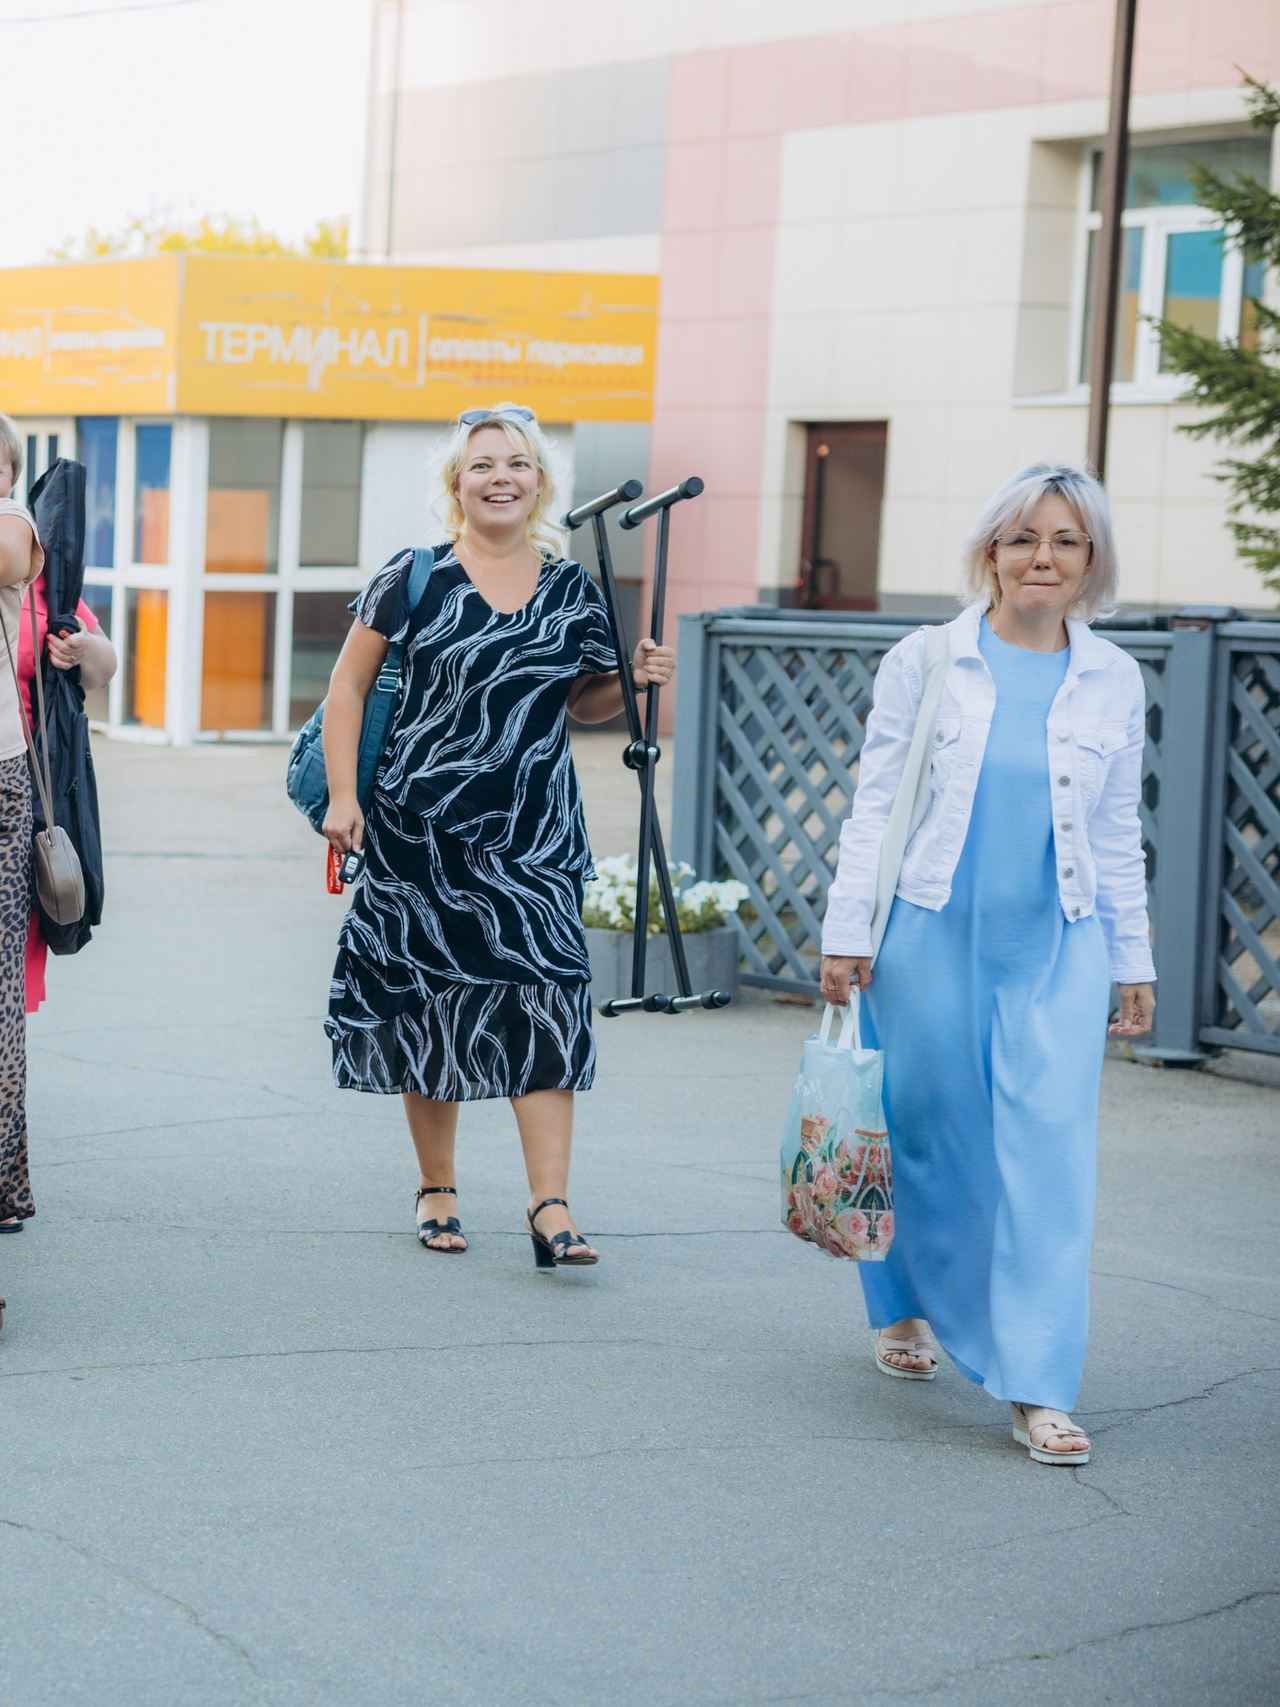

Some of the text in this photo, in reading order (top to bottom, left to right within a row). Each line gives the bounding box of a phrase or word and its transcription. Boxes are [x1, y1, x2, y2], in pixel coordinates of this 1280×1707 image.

[198, 321, 408, 368] ТЕРМИНАЛ
[428, 337, 522, 362] оплаты
[525, 340, 644, 370] парковки
